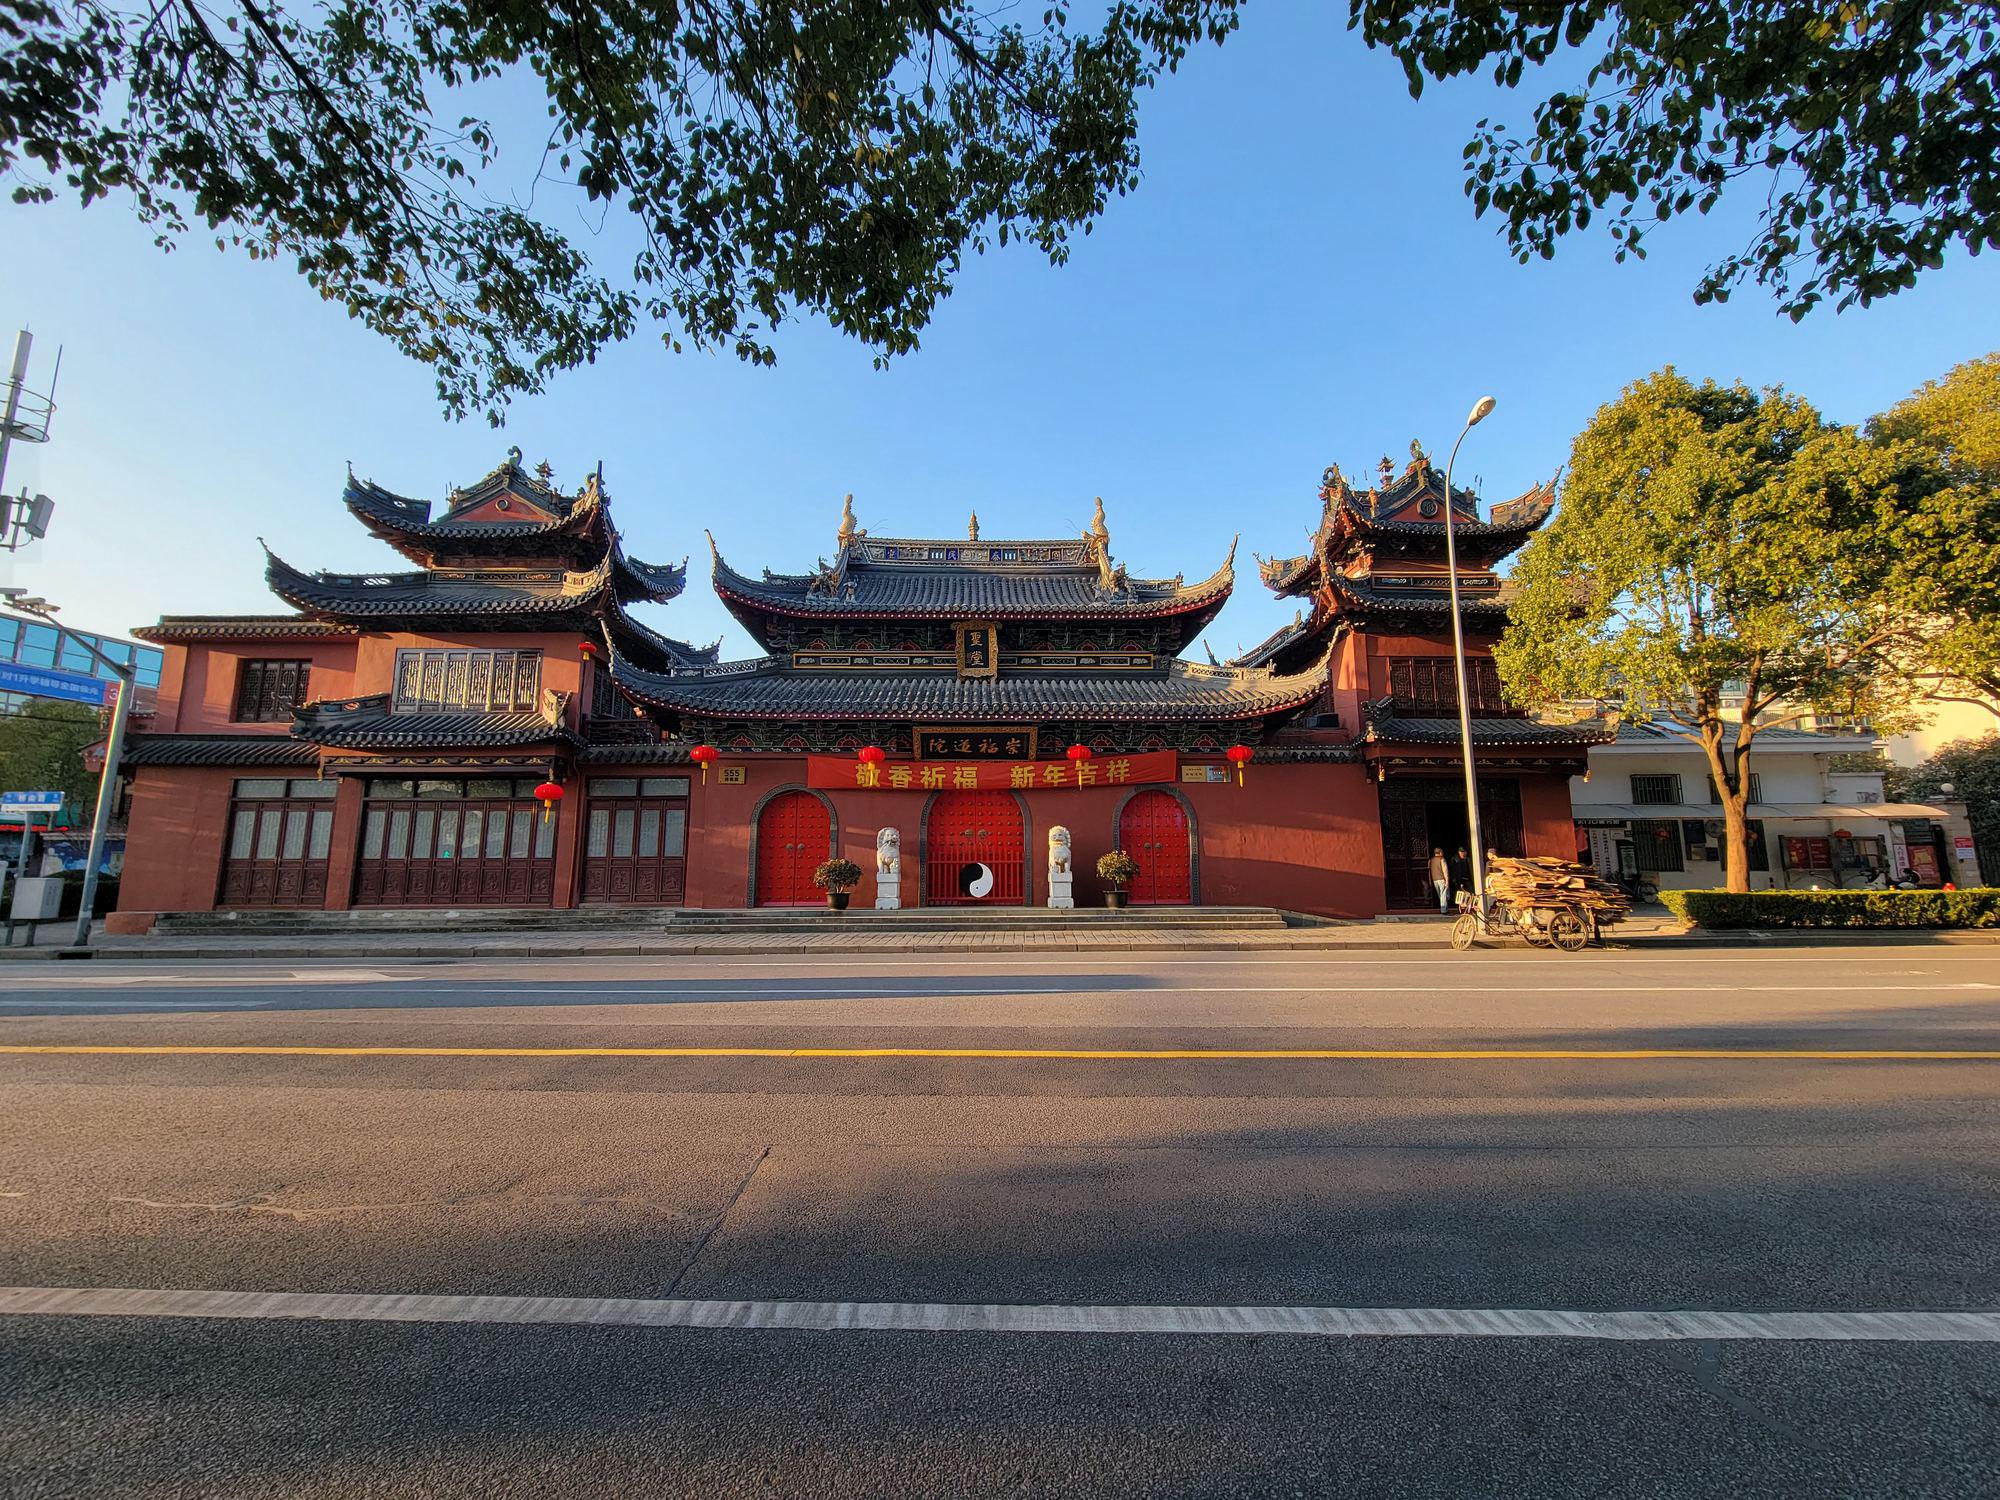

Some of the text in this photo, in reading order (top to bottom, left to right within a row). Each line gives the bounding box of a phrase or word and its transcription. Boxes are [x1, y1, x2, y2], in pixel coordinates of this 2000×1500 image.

[856, 759, 1131, 789] 敬香祈福 新年吉祥
